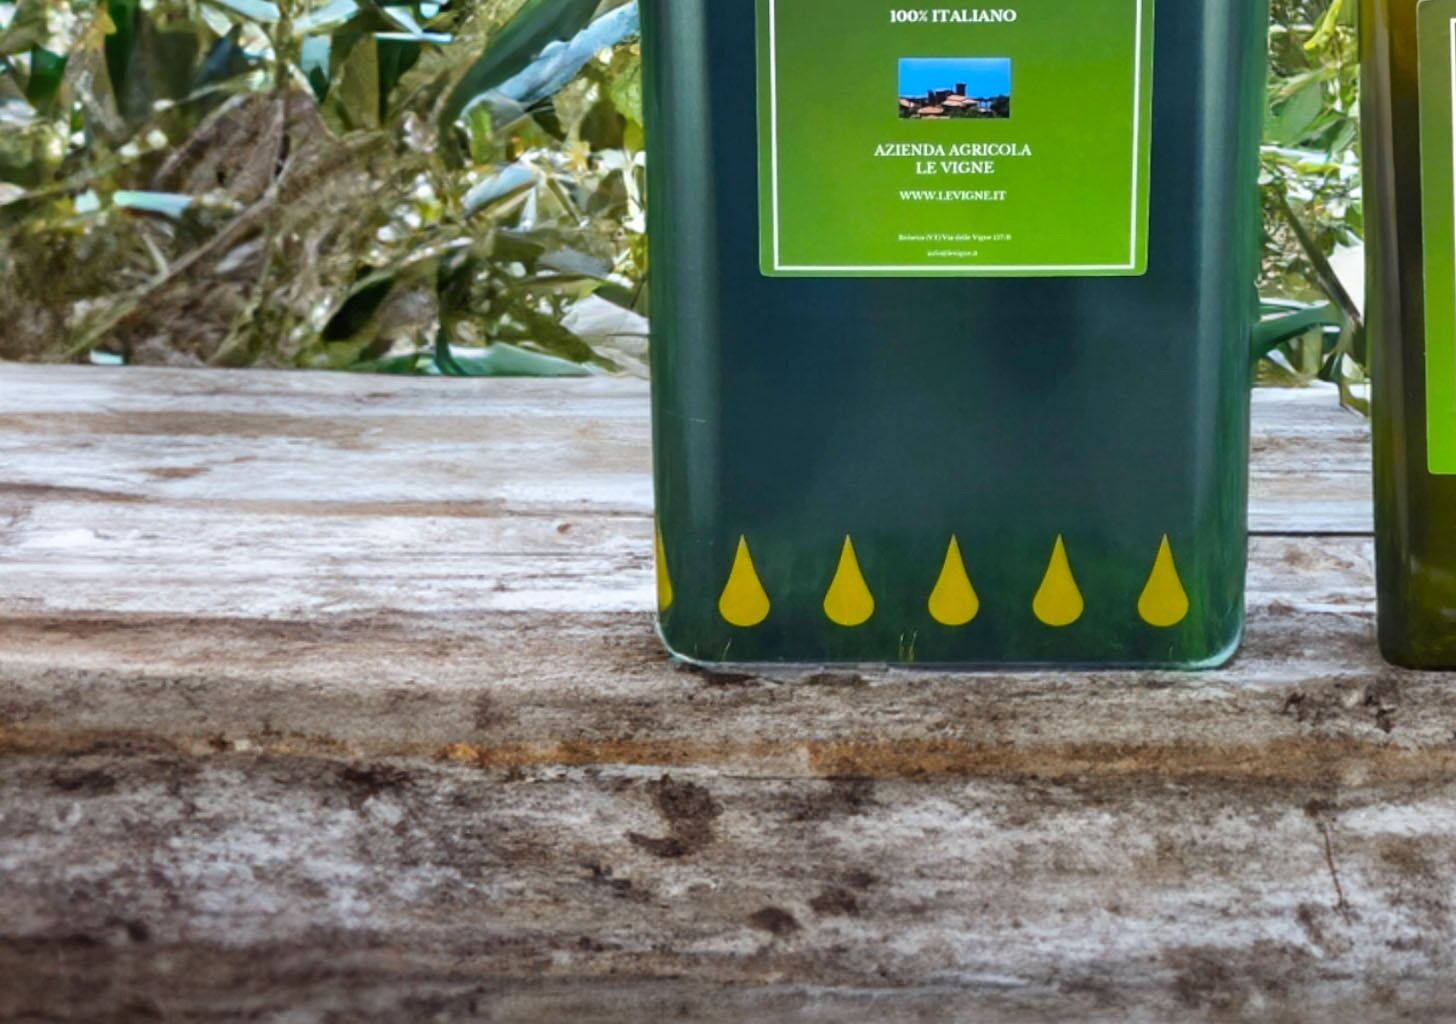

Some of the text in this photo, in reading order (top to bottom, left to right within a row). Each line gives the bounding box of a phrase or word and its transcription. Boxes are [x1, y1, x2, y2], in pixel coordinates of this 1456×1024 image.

[890, 8, 1017, 23] 100% ITALIANO
[873, 142, 1032, 157] AZIENDA AGRICOLA
[915, 160, 995, 175] LE VIGNE
[899, 190, 1007, 201] WWW.LEVIGNE.IT
